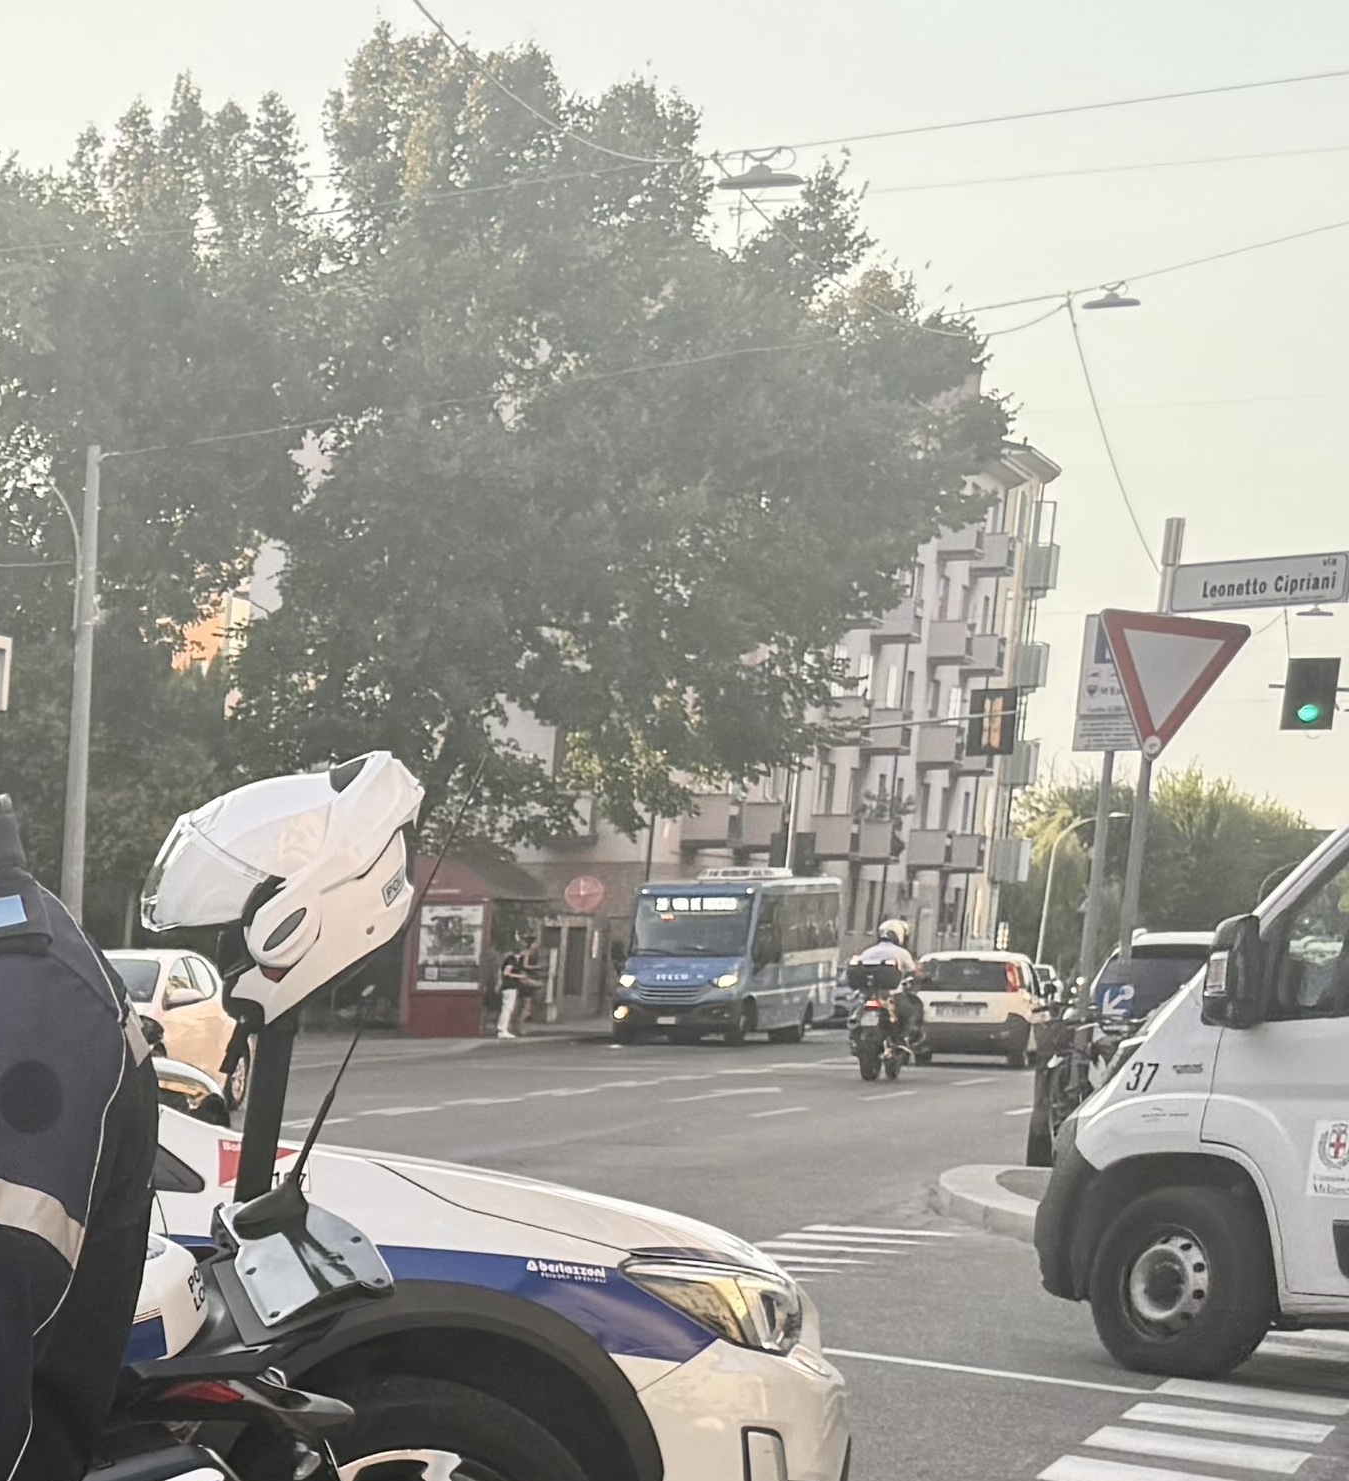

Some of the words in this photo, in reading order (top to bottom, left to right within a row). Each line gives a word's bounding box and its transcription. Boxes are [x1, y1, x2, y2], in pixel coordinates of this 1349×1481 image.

[1322, 557, 1338, 566] via
[1202, 577, 1267, 598] Leonetto
[1274, 571, 1337, 595] Cipriani
[1126, 1061, 1159, 1093] 37
